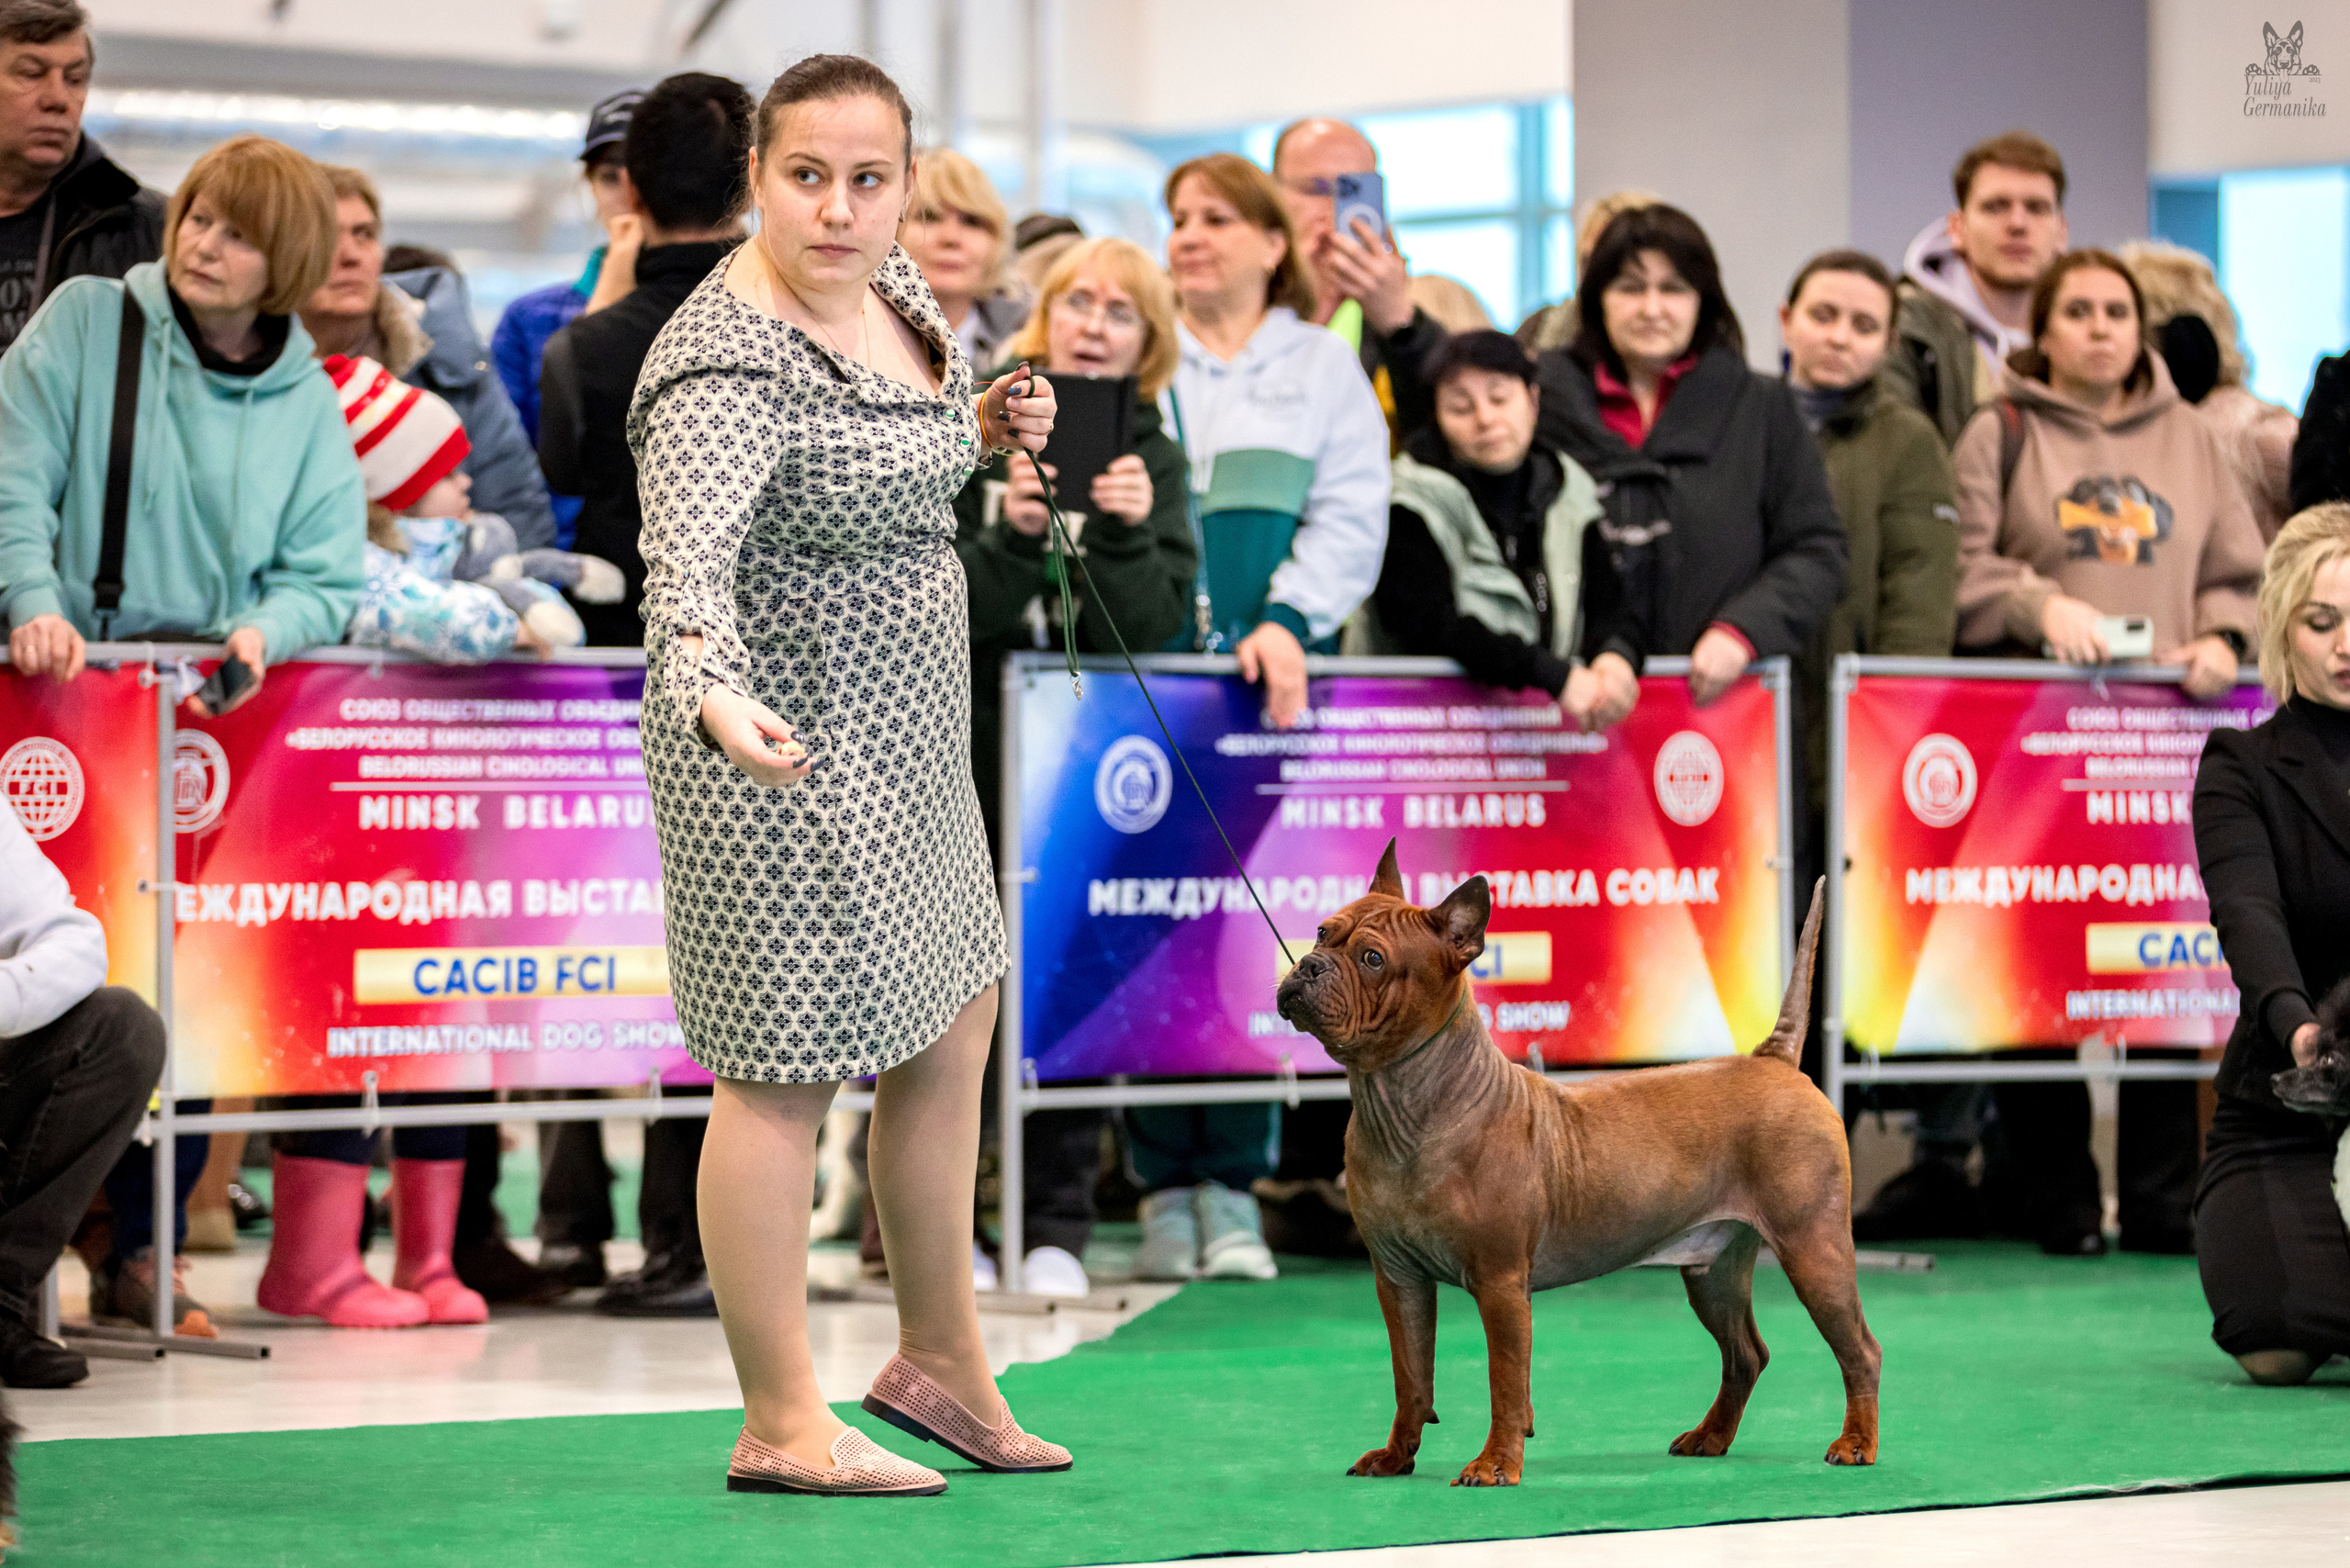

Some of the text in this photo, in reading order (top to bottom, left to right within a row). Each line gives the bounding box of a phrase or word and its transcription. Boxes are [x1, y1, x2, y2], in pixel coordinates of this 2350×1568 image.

[359, 794, 655, 830] MINSK BELARU
[1281, 793, 1546, 830] MINSK BELARUS
[2087, 790, 2192, 824] MINSK
[175, 879, 512, 927] ЕЖДУНАРОДНАЯ
[1088, 868, 1719, 919] МЕЖДУНАРОДН ВЫТАВКА СОБАК
[1906, 864, 2209, 908] МЕЖДУНАРОДНА
[413, 956, 616, 995] CACIB FCI
[1496, 1001, 1571, 1033] SHOW
[327, 1022, 533, 1058] INTERNATIONAL
[542, 1020, 604, 1050] DOG
